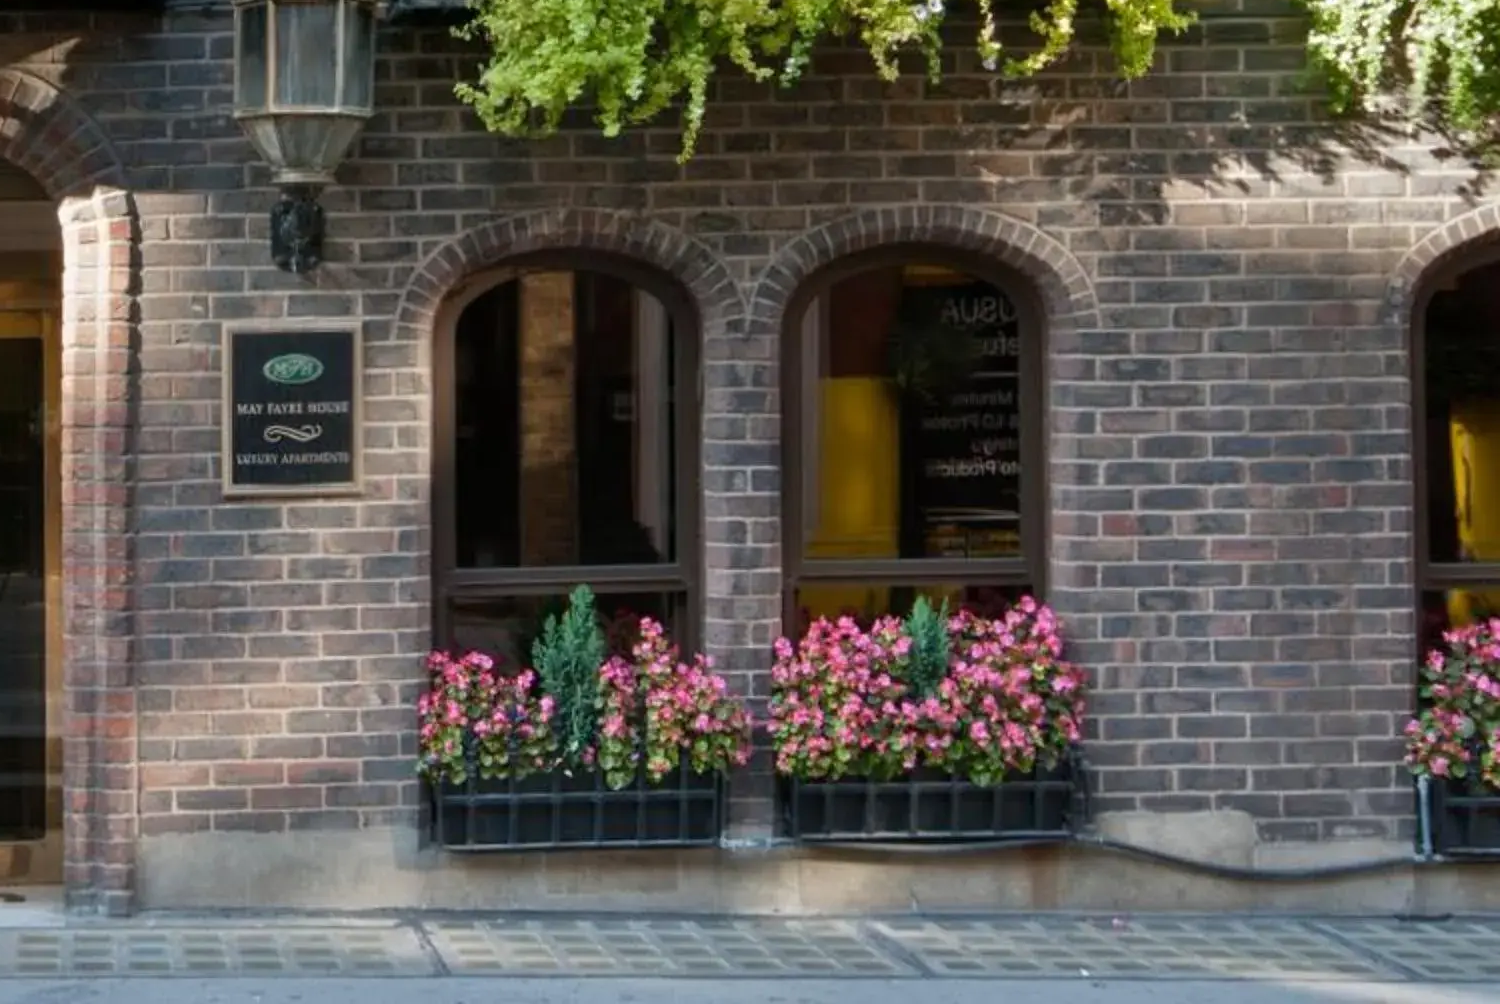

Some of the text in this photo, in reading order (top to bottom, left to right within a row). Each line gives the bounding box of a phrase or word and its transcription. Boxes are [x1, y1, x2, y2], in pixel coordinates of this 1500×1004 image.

[236, 400, 350, 416] MAY FAYRE HOUSE
[236, 451, 349, 465] LUXURY APARTMENTS
